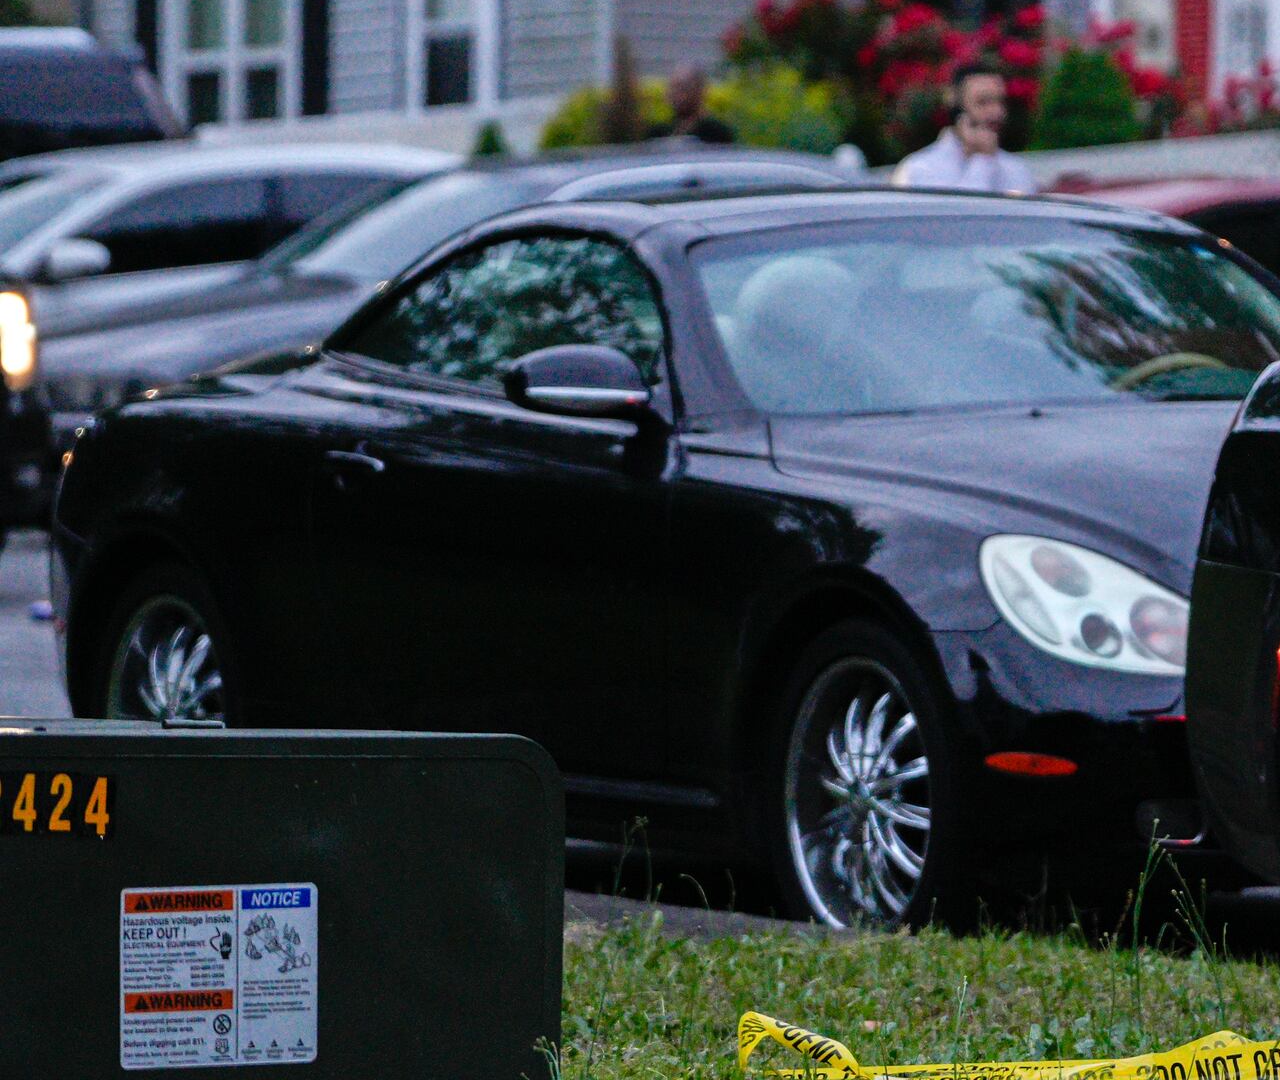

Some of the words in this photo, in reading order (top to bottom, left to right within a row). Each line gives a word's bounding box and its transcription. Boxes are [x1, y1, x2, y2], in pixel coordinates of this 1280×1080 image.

[0, 773, 110, 836] 424
[150, 892, 223, 910] WARNING
[251, 891, 302, 906] NOTICE
[123, 928, 153, 940] KEEP
[156, 927, 180, 939] OUT
[150, 992, 223, 1010] WARNING
[1196, 1052, 1243, 1080] NOT
